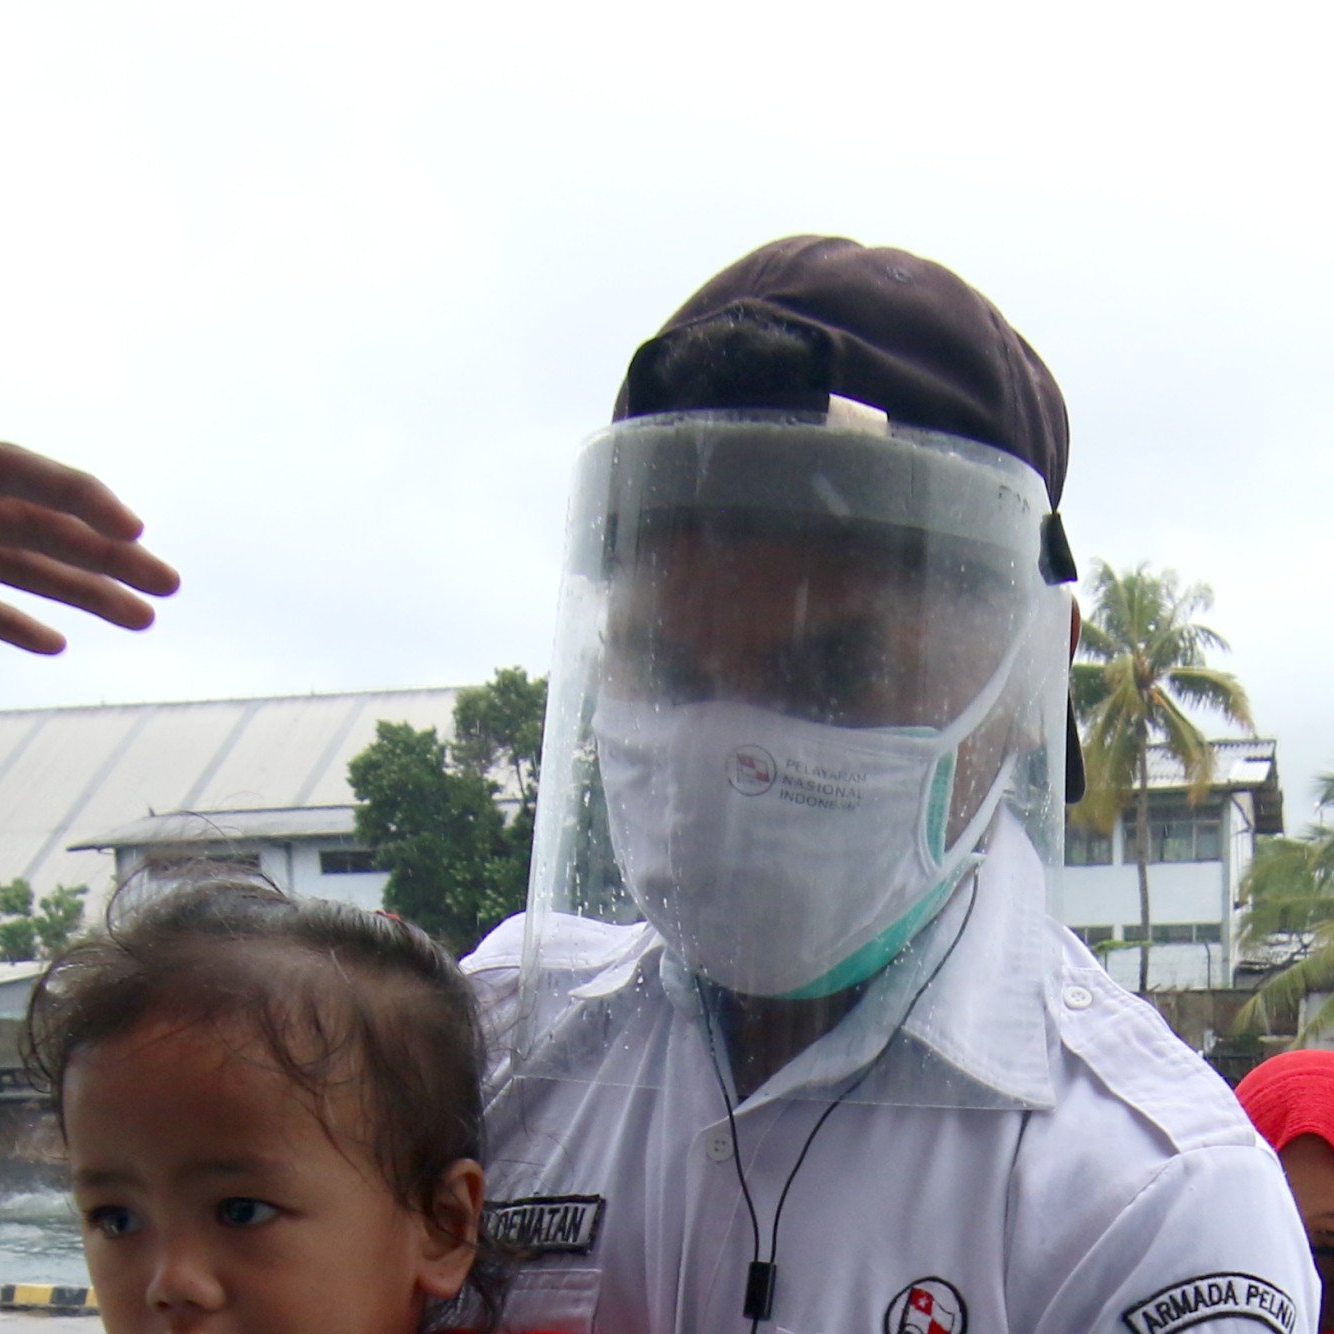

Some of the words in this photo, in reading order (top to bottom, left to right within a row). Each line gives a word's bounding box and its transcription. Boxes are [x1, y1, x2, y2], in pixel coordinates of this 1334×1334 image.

[779, 788, 859, 812] INDONE
[781, 774, 862, 800] NASIONAL
[1142, 1280, 1239, 1334] ARMADA
[1245, 1284, 1293, 1329] PELNI
